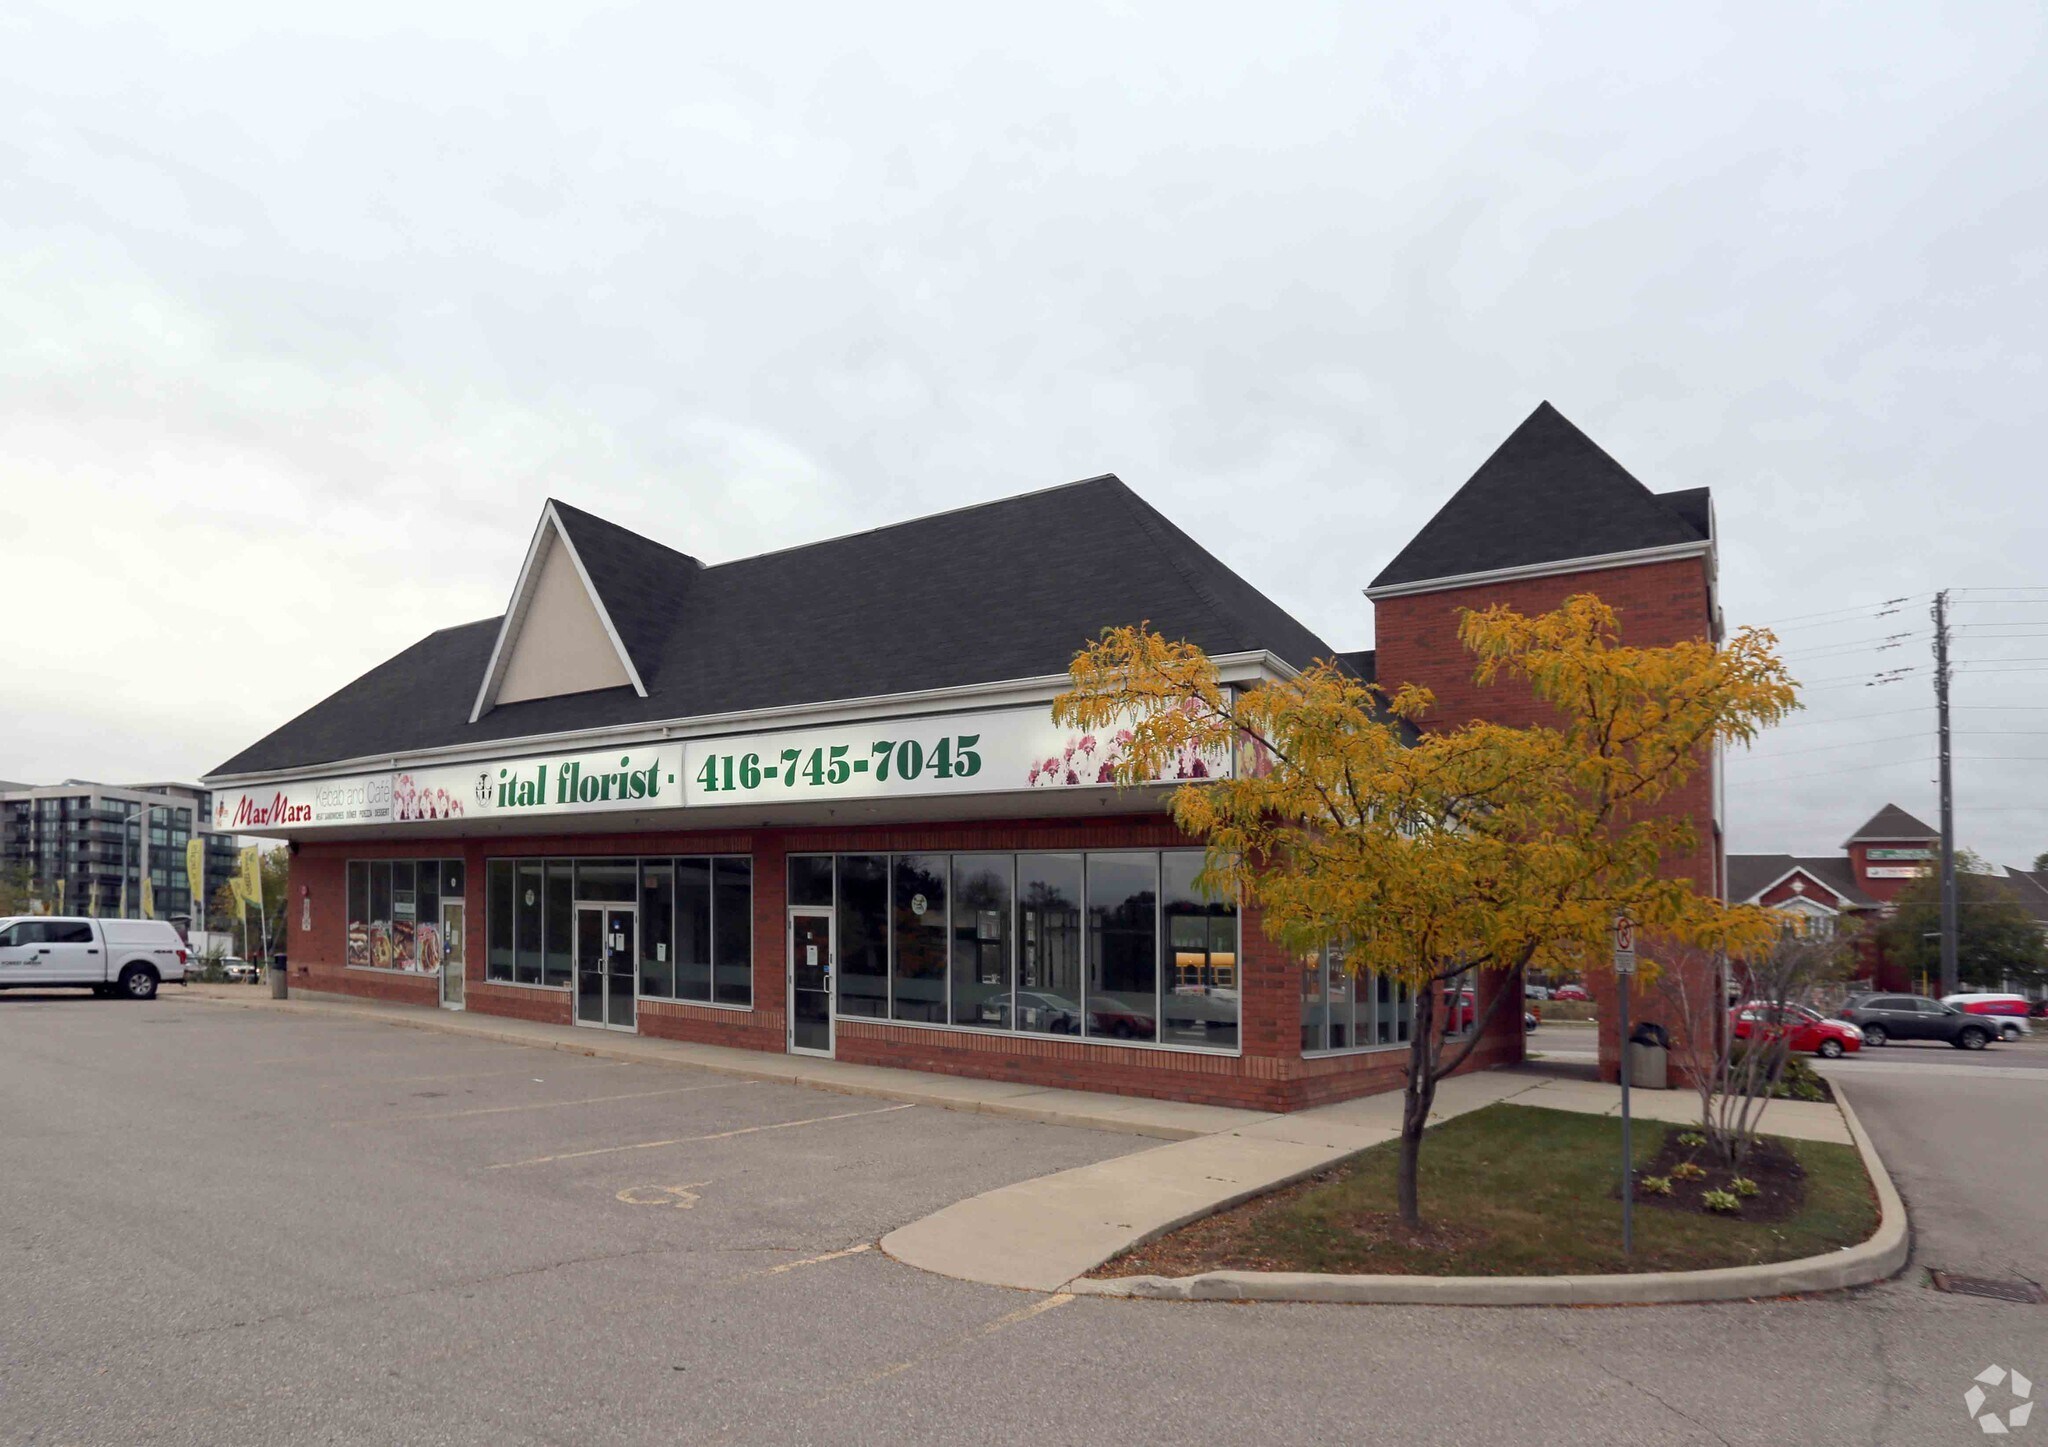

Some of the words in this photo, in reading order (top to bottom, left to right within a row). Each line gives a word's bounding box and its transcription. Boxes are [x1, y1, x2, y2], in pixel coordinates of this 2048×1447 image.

[555, 756, 661, 804] florist
[696, 735, 982, 793] 416-745-7045
[232, 791, 312, 827] MarMara
